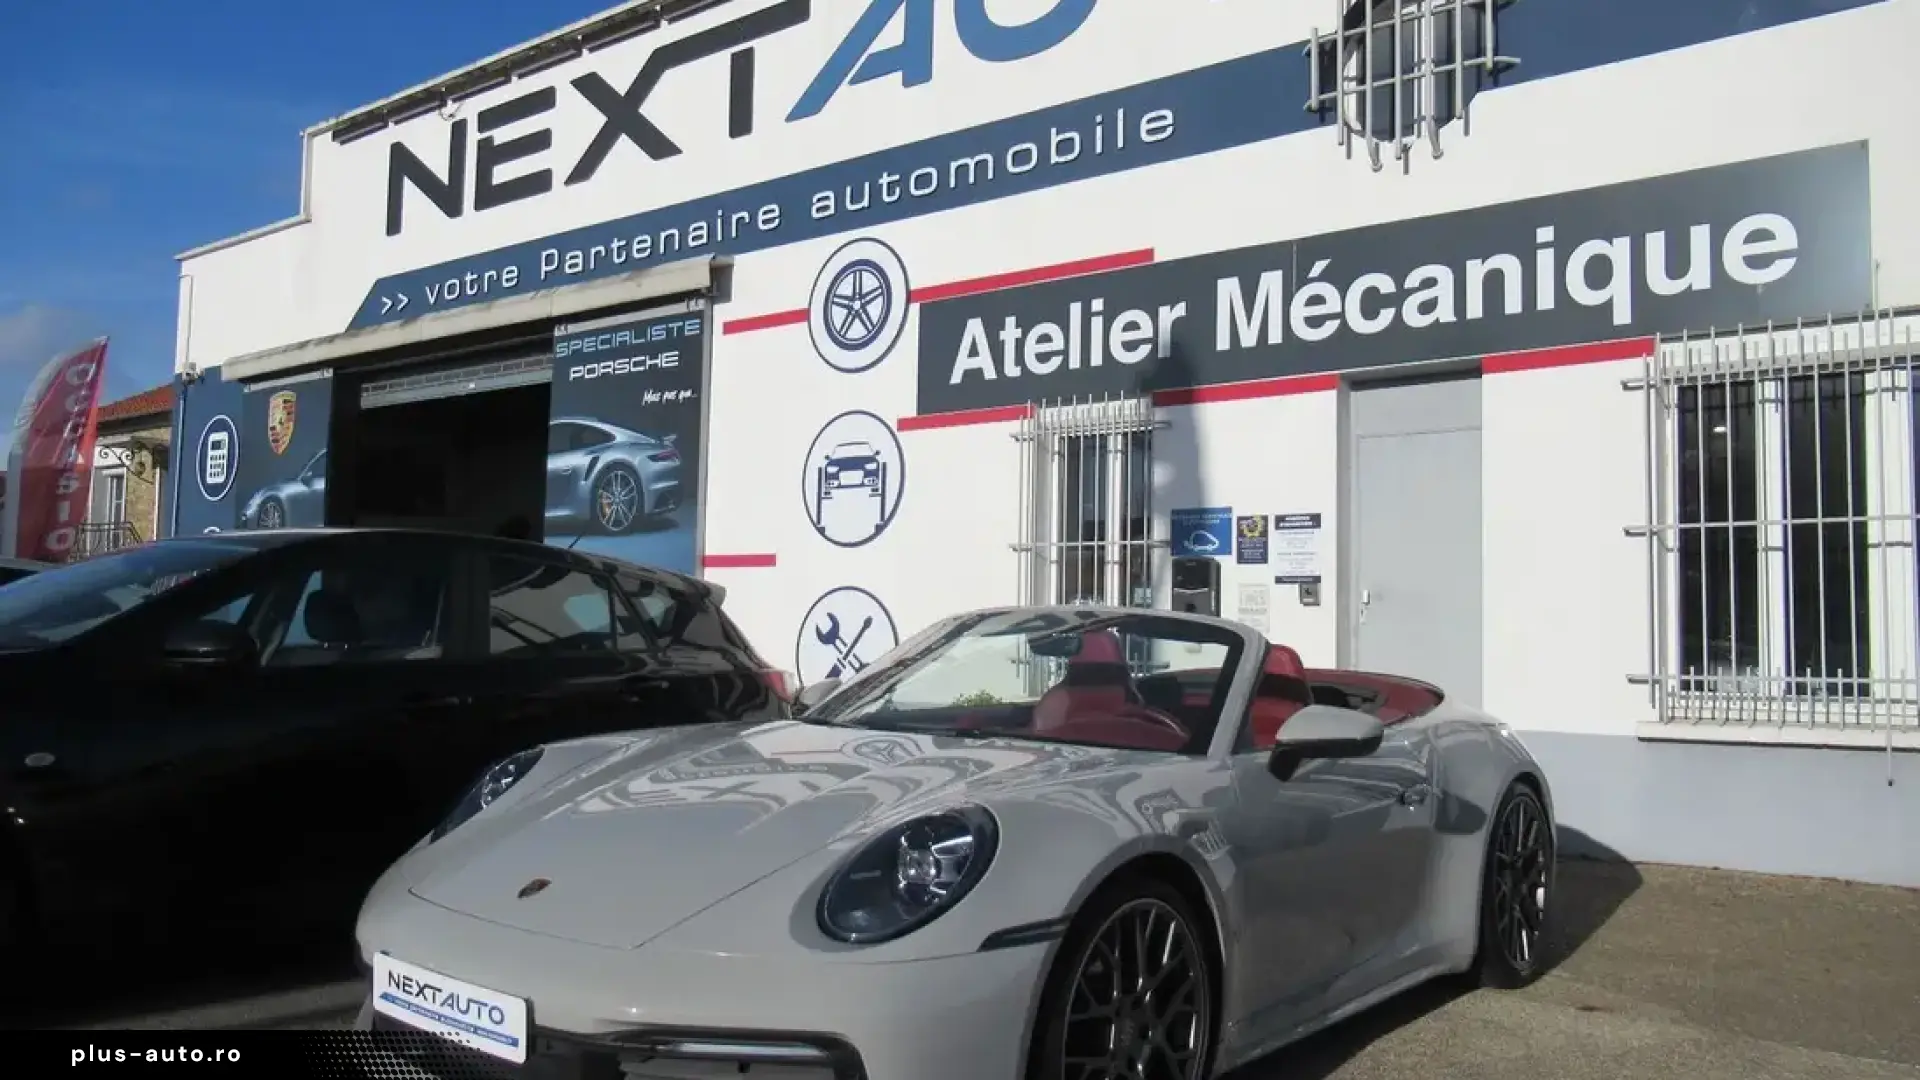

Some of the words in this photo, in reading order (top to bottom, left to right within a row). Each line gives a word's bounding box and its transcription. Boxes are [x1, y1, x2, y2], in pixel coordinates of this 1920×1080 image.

[426, 271, 517, 305] votre
[540, 204, 780, 280] Partenaire
[811, 107, 1175, 219] automobile
[949, 302, 1187, 384] Atelier
[1216, 213, 1799, 351] Mécanique
[555, 318, 702, 358] SPECIALISTE
[568, 350, 680, 382] PORSCHE
[388, 970, 506, 1025] NEXTAUTO
